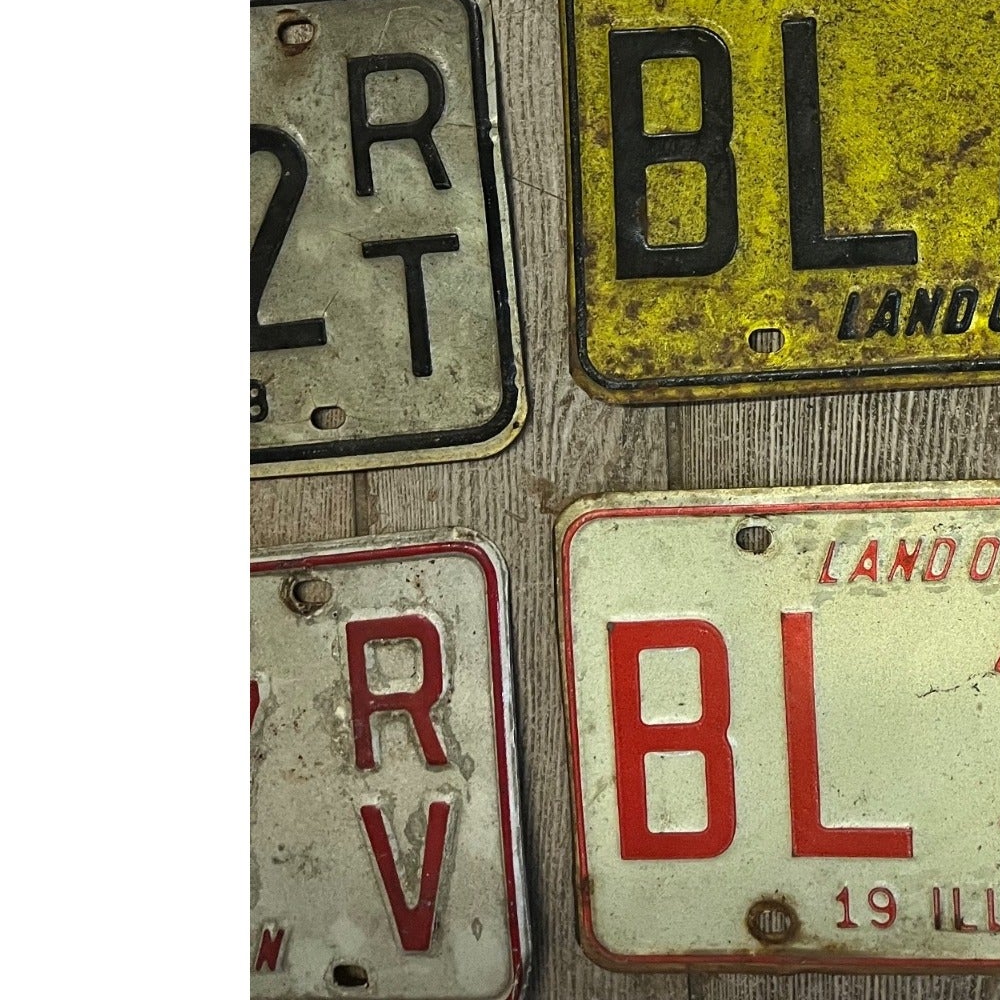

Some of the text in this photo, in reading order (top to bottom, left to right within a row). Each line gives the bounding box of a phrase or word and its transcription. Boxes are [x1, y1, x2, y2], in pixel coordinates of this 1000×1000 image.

[608, 16, 918, 281] BL
[837, 286, 979, 341] LAND
[819, 537, 957, 583] LAND
[608, 611, 914, 861] BL
[836, 886, 898, 930] 19
